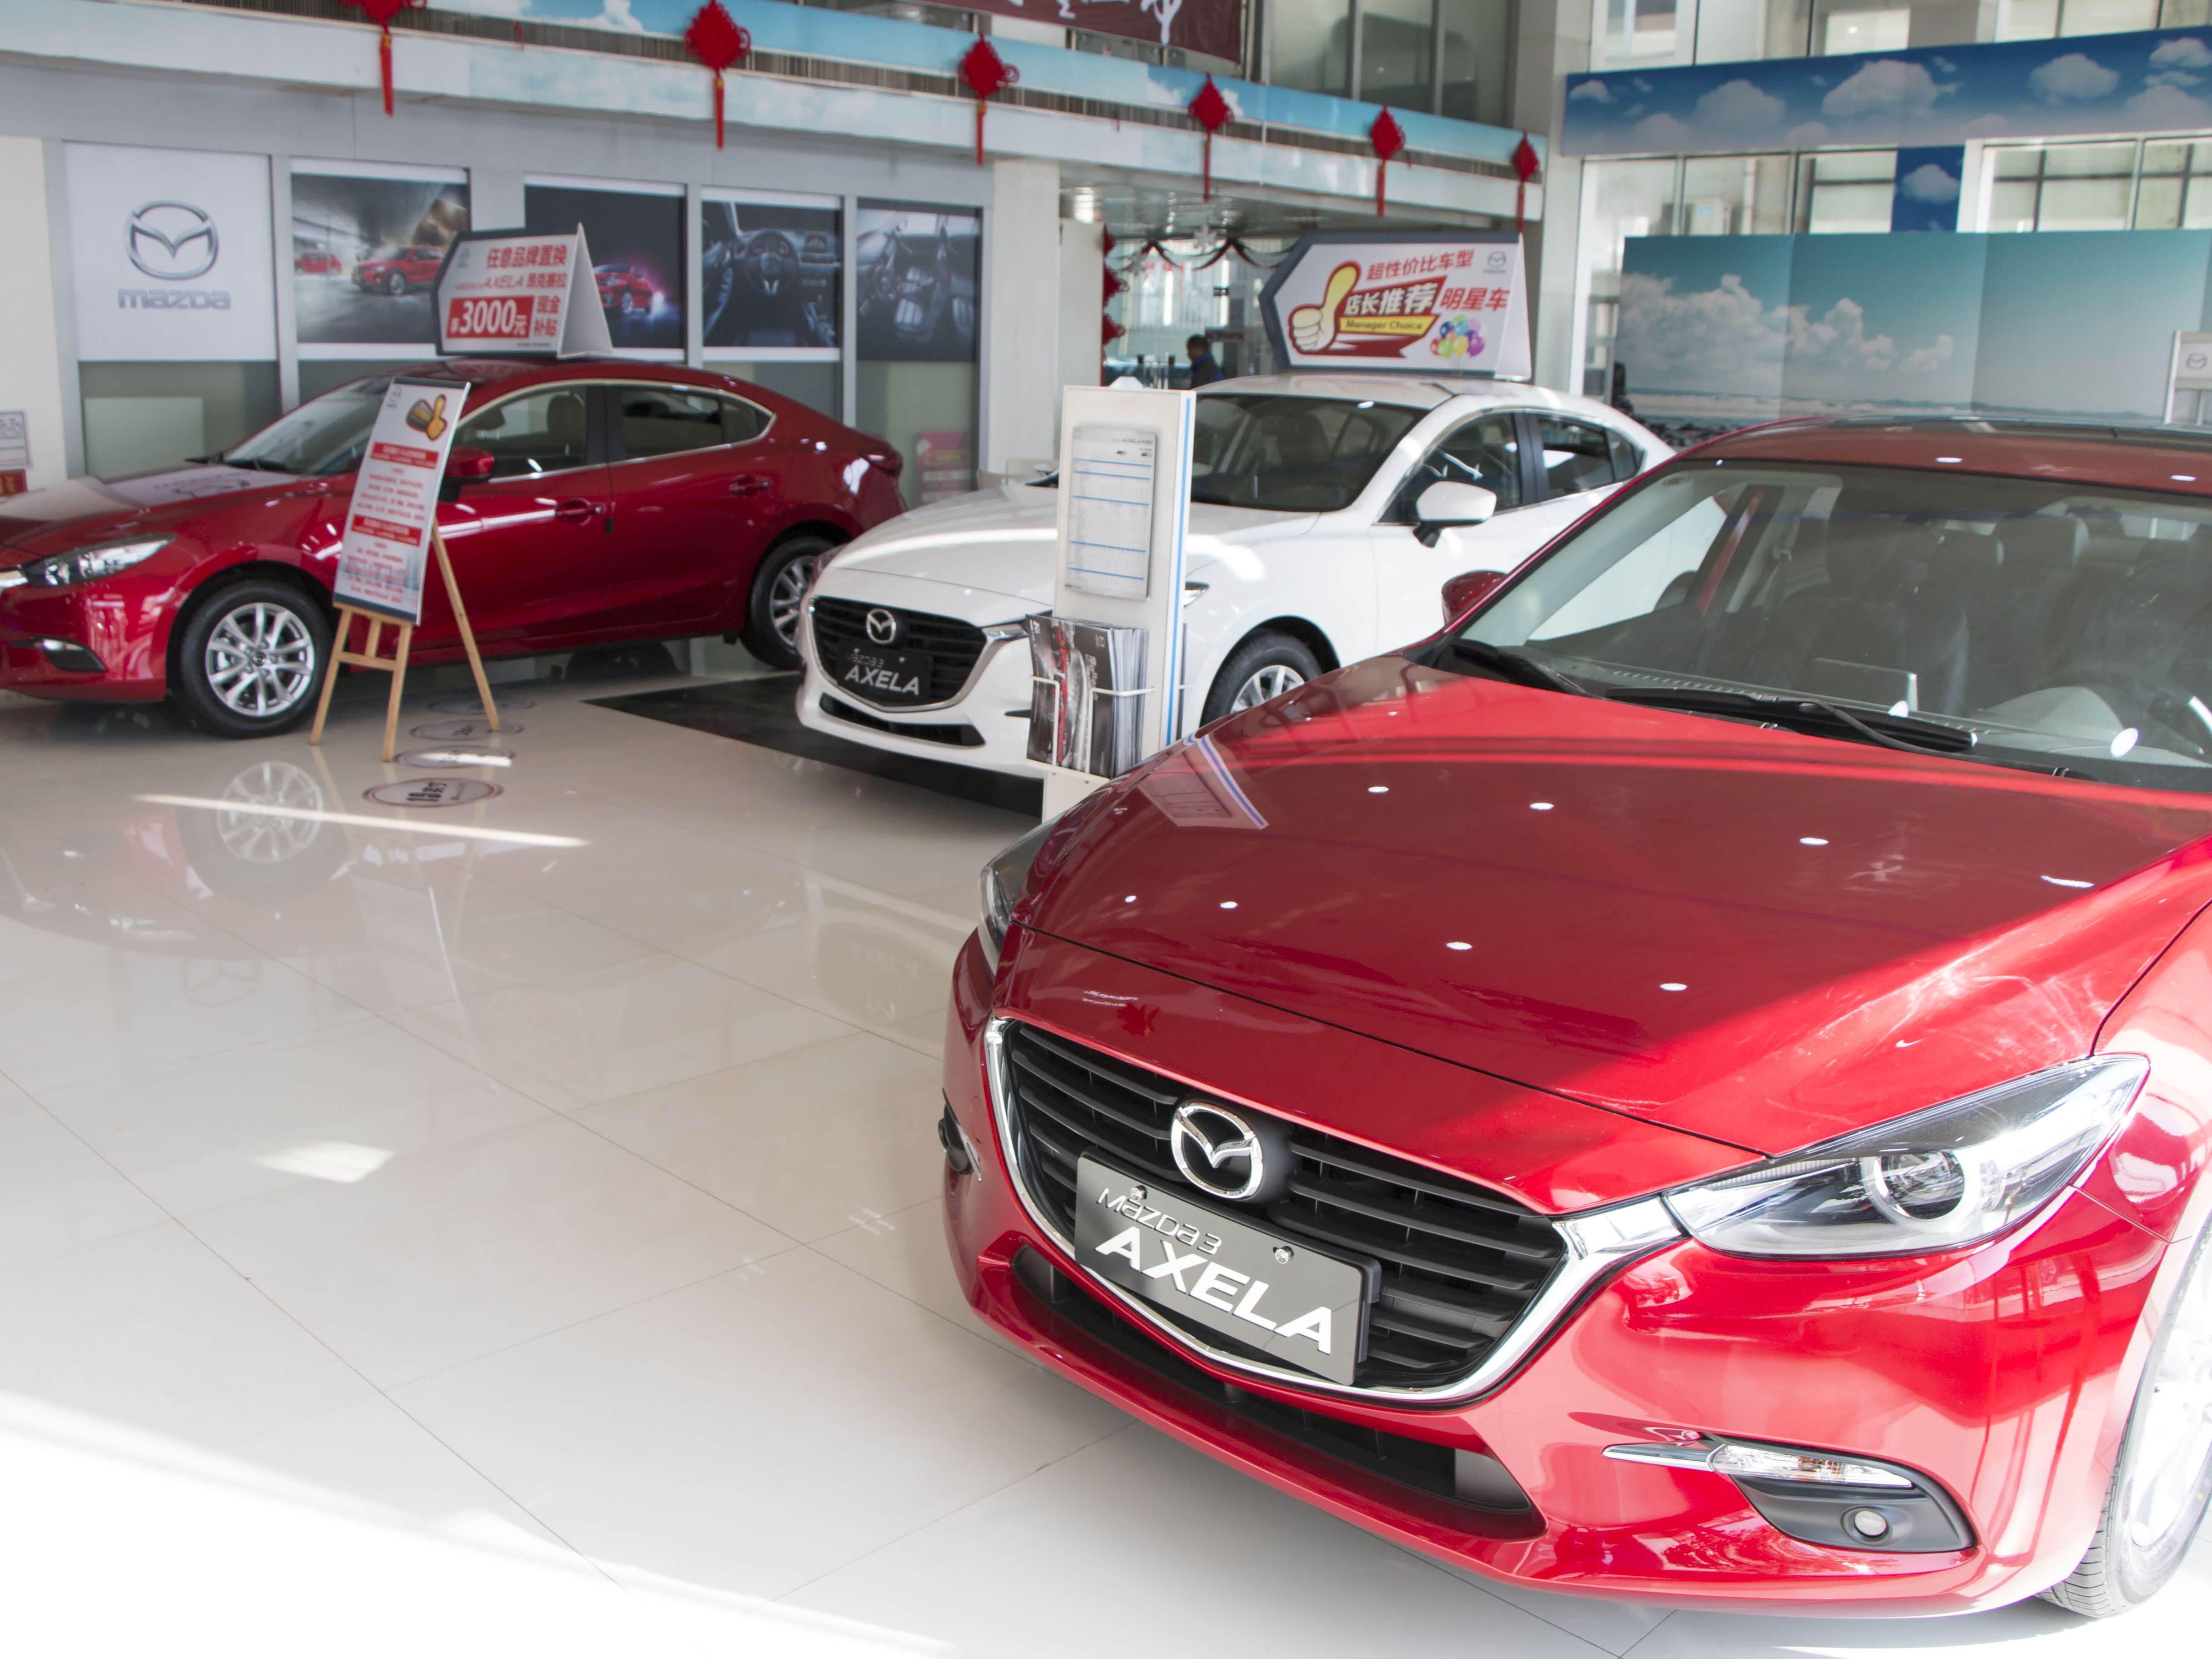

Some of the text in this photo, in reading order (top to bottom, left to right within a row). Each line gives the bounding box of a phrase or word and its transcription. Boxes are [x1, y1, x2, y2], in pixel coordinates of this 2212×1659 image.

[1367, 249, 1474, 281] 超性价比车型
[1343, 282, 1510, 317] 店长推荐 明星车
[1346, 319, 1423, 330] Manager Choice
[844, 664, 920, 696] AXELA
[1094, 1226, 1332, 1356] AXELA
